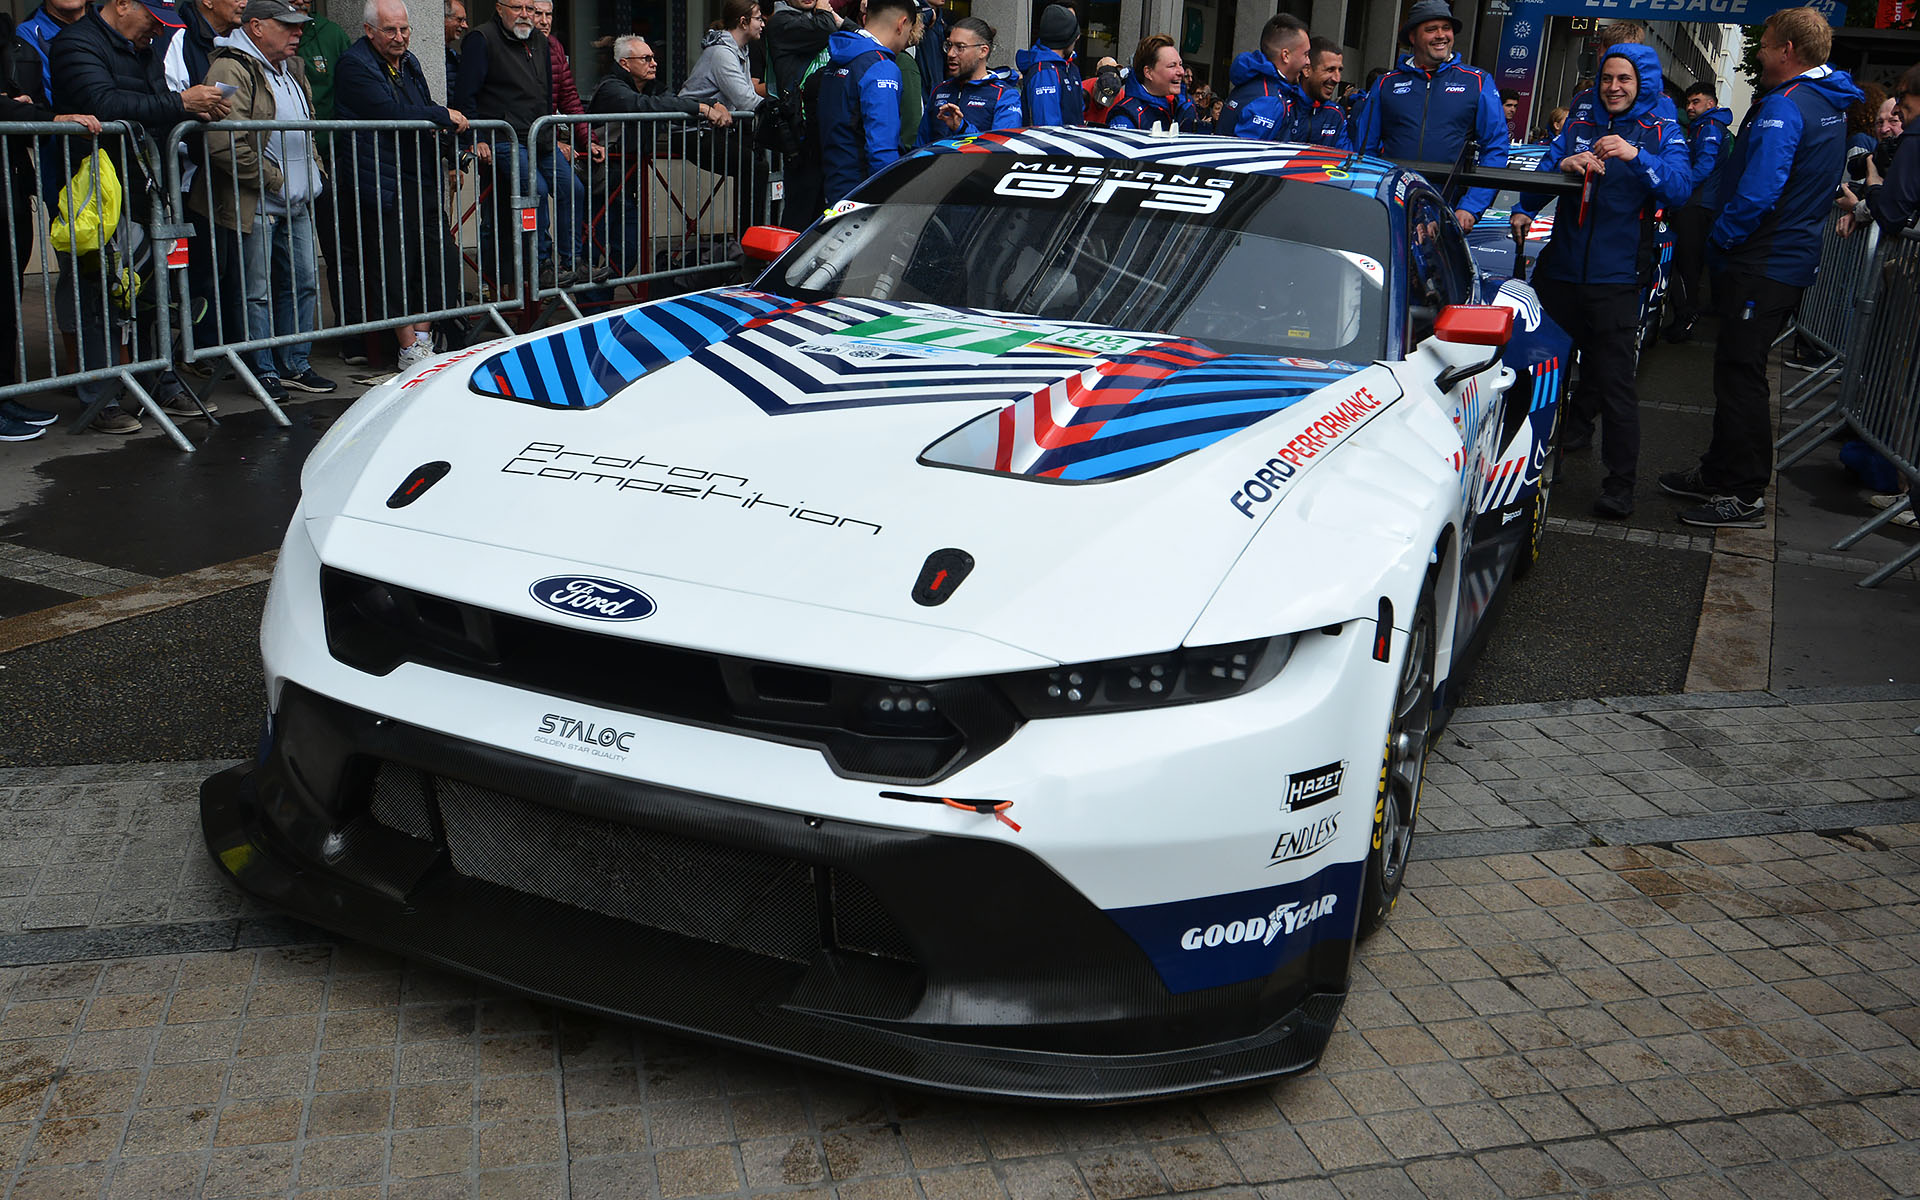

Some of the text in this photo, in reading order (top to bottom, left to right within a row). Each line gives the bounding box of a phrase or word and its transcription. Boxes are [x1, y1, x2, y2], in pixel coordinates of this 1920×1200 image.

[1510, 47, 1527, 57] FIA
[1011, 161, 1235, 189] MUSTANG
[993, 171, 1226, 215] GT3
[866, 318, 1019, 348] 77
[1056, 336, 1122, 351] GT3
[1076, 332, 1129, 344] LM
[519, 442, 749, 487] Proton
[501, 457, 883, 535] Competition
[550, 579, 636, 617] Ford
[534, 735, 628, 762] GOLDEN STAR QUALITY
[538, 713, 635, 752] STALOC
[1289, 770, 1342, 803] HAZET
[1271, 811, 1342, 860] ENDLESS
